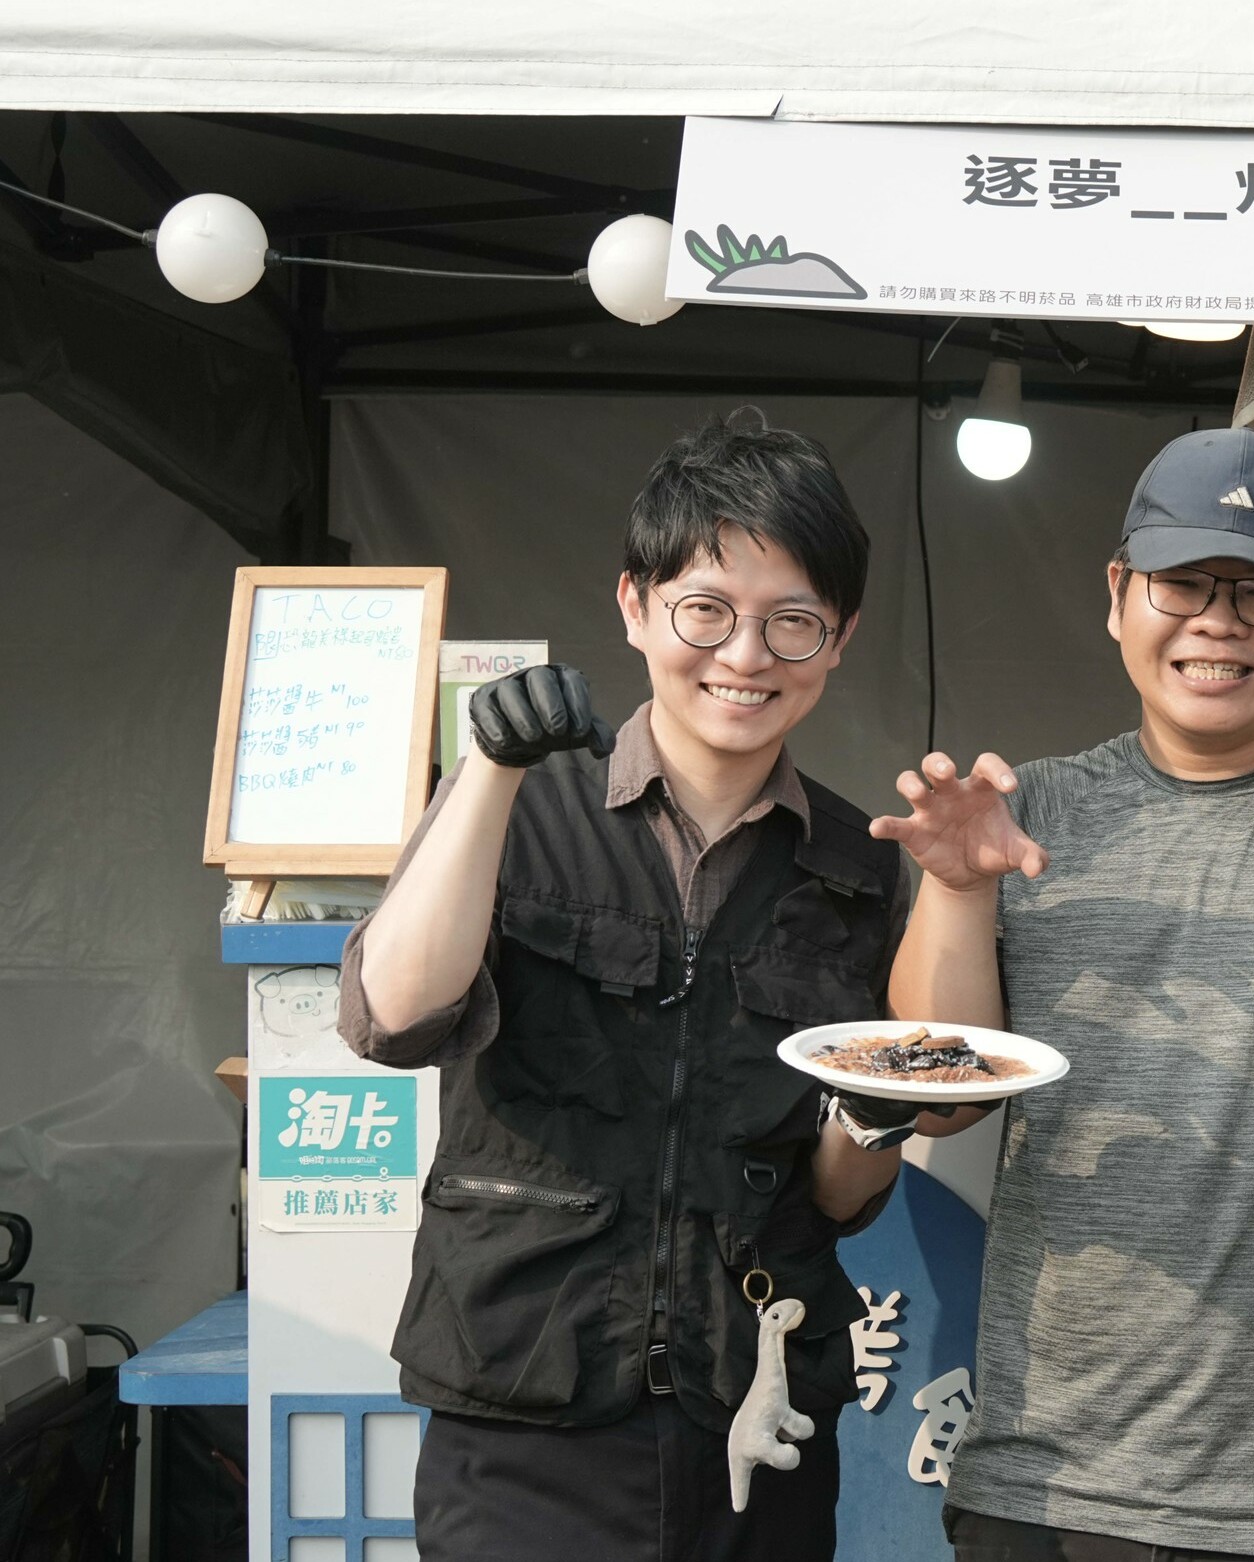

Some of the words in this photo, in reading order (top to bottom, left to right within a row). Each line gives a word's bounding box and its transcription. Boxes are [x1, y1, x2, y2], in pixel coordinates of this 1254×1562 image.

[879, 285, 1076, 306] 請勿購買來路不明菸品
[272, 594, 393, 624] TACO
[461, 656, 526, 673] TWQR
[346, 695, 369, 710] 100
[346, 722, 365, 737] 90
[341, 760, 356, 776] 80
[278, 1088, 399, 1150] 淘卡
[283, 1189, 398, 1216] 推薦店家
